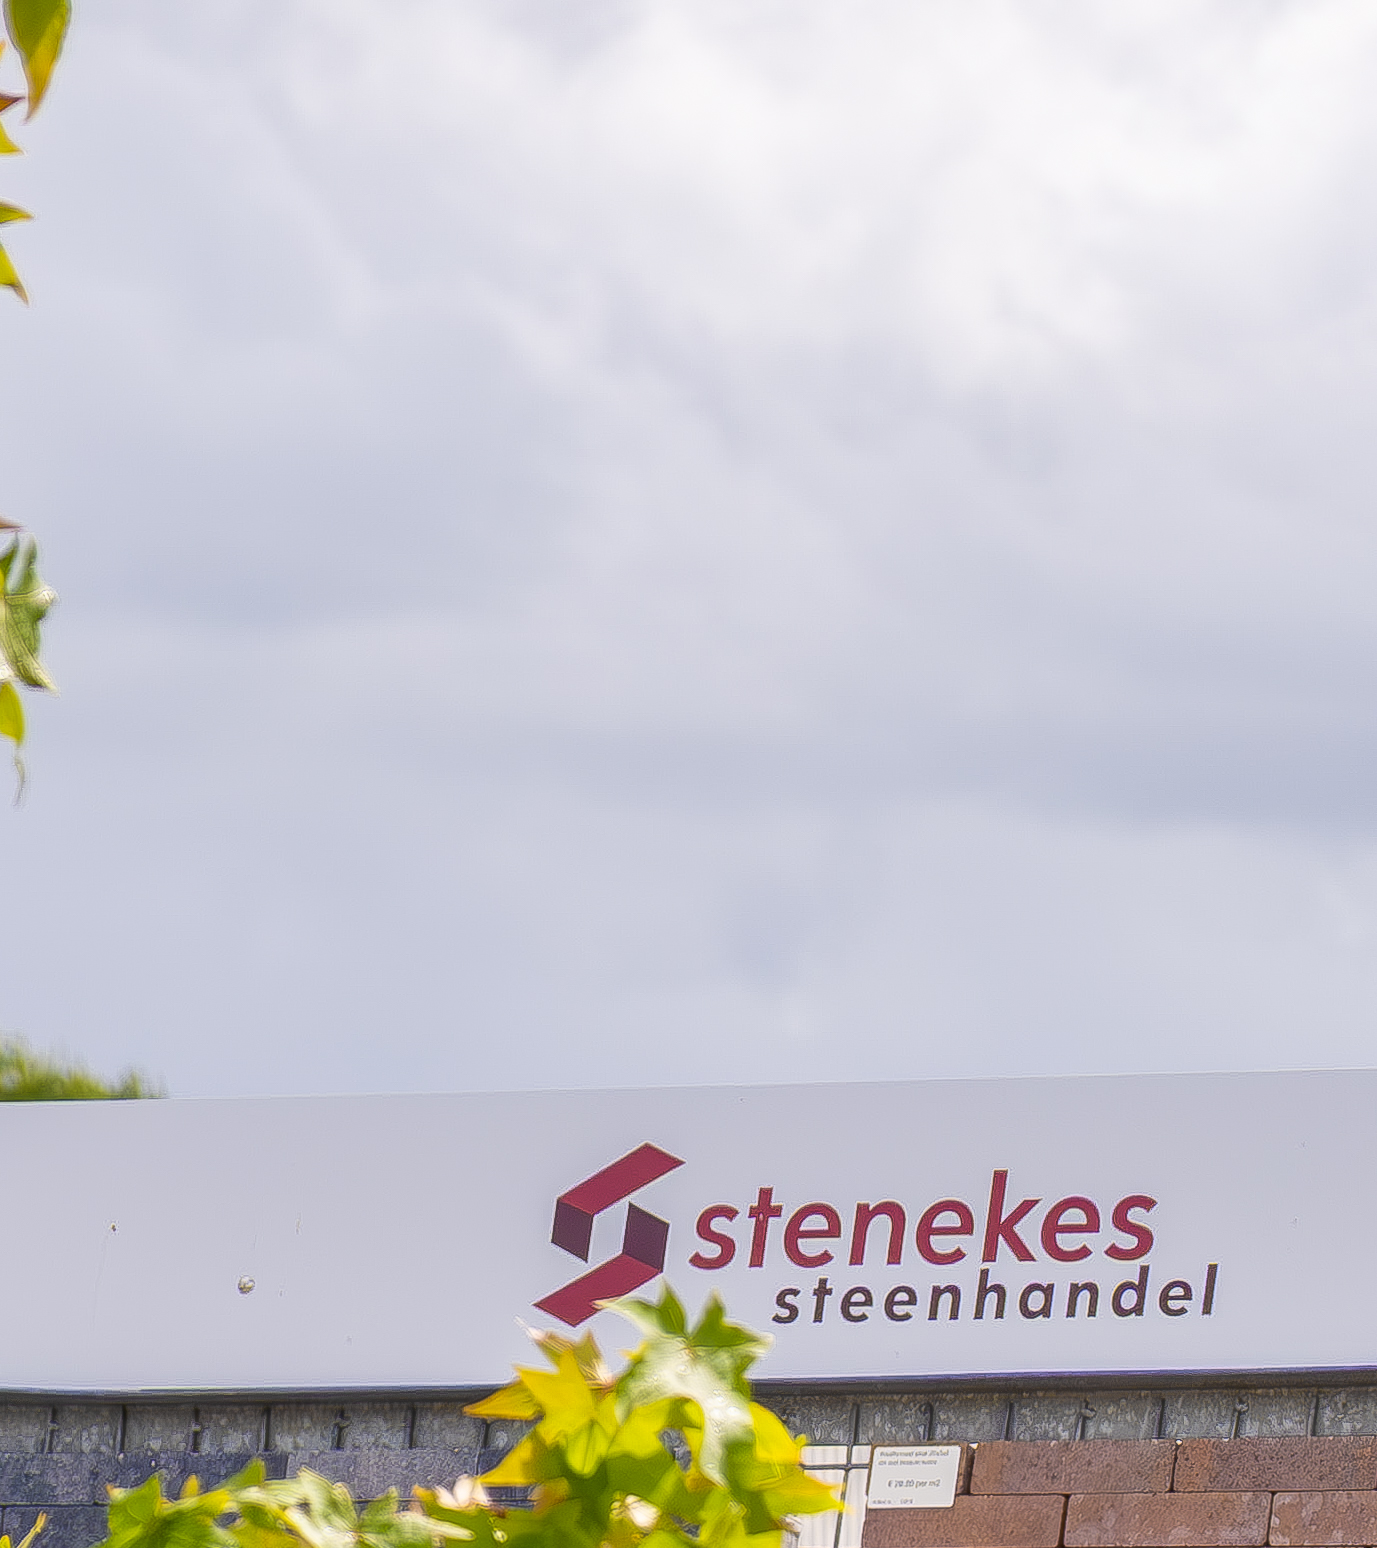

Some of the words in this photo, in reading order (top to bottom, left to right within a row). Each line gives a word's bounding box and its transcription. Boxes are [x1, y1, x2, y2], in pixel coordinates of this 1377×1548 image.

[689, 1169, 1158, 1270] stenekes
[772, 1264, 1219, 1323] steenhandel
[915, 1480, 928, 1489] per
[928, 1479, 941, 1488] m2
